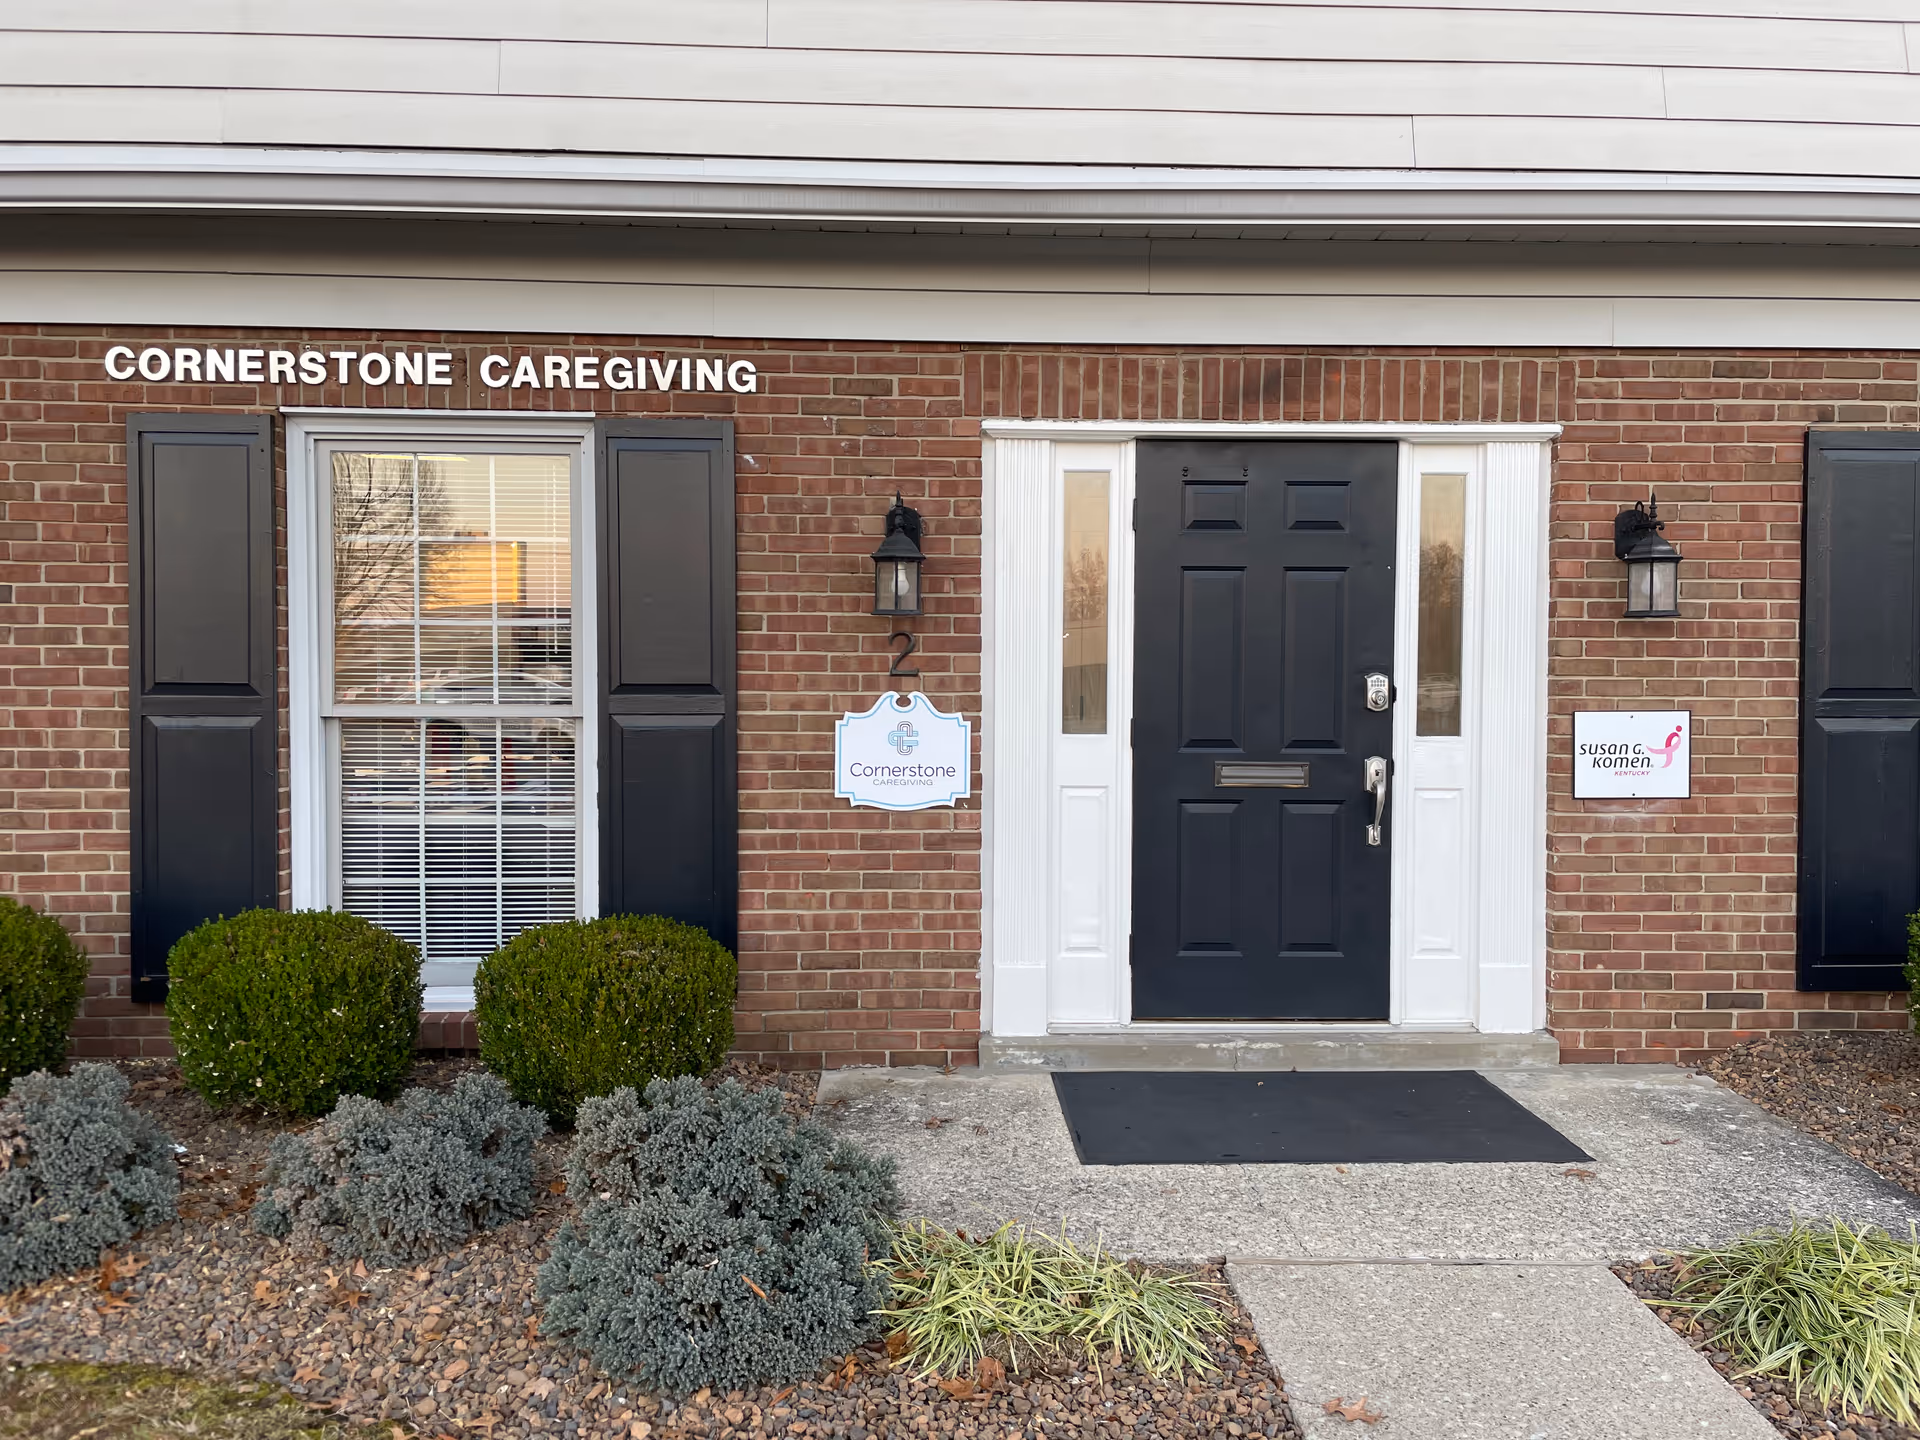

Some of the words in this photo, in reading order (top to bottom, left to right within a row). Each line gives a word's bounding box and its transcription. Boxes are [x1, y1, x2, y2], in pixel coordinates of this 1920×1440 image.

[104, 346, 453, 386] CORNERSTONE
[479, 354, 758, 393] CAREGIVING
[888, 630, 920, 677] 2
[849, 762, 956, 778] Cornerstone
[872, 778, 934, 786] CAREGIVING
